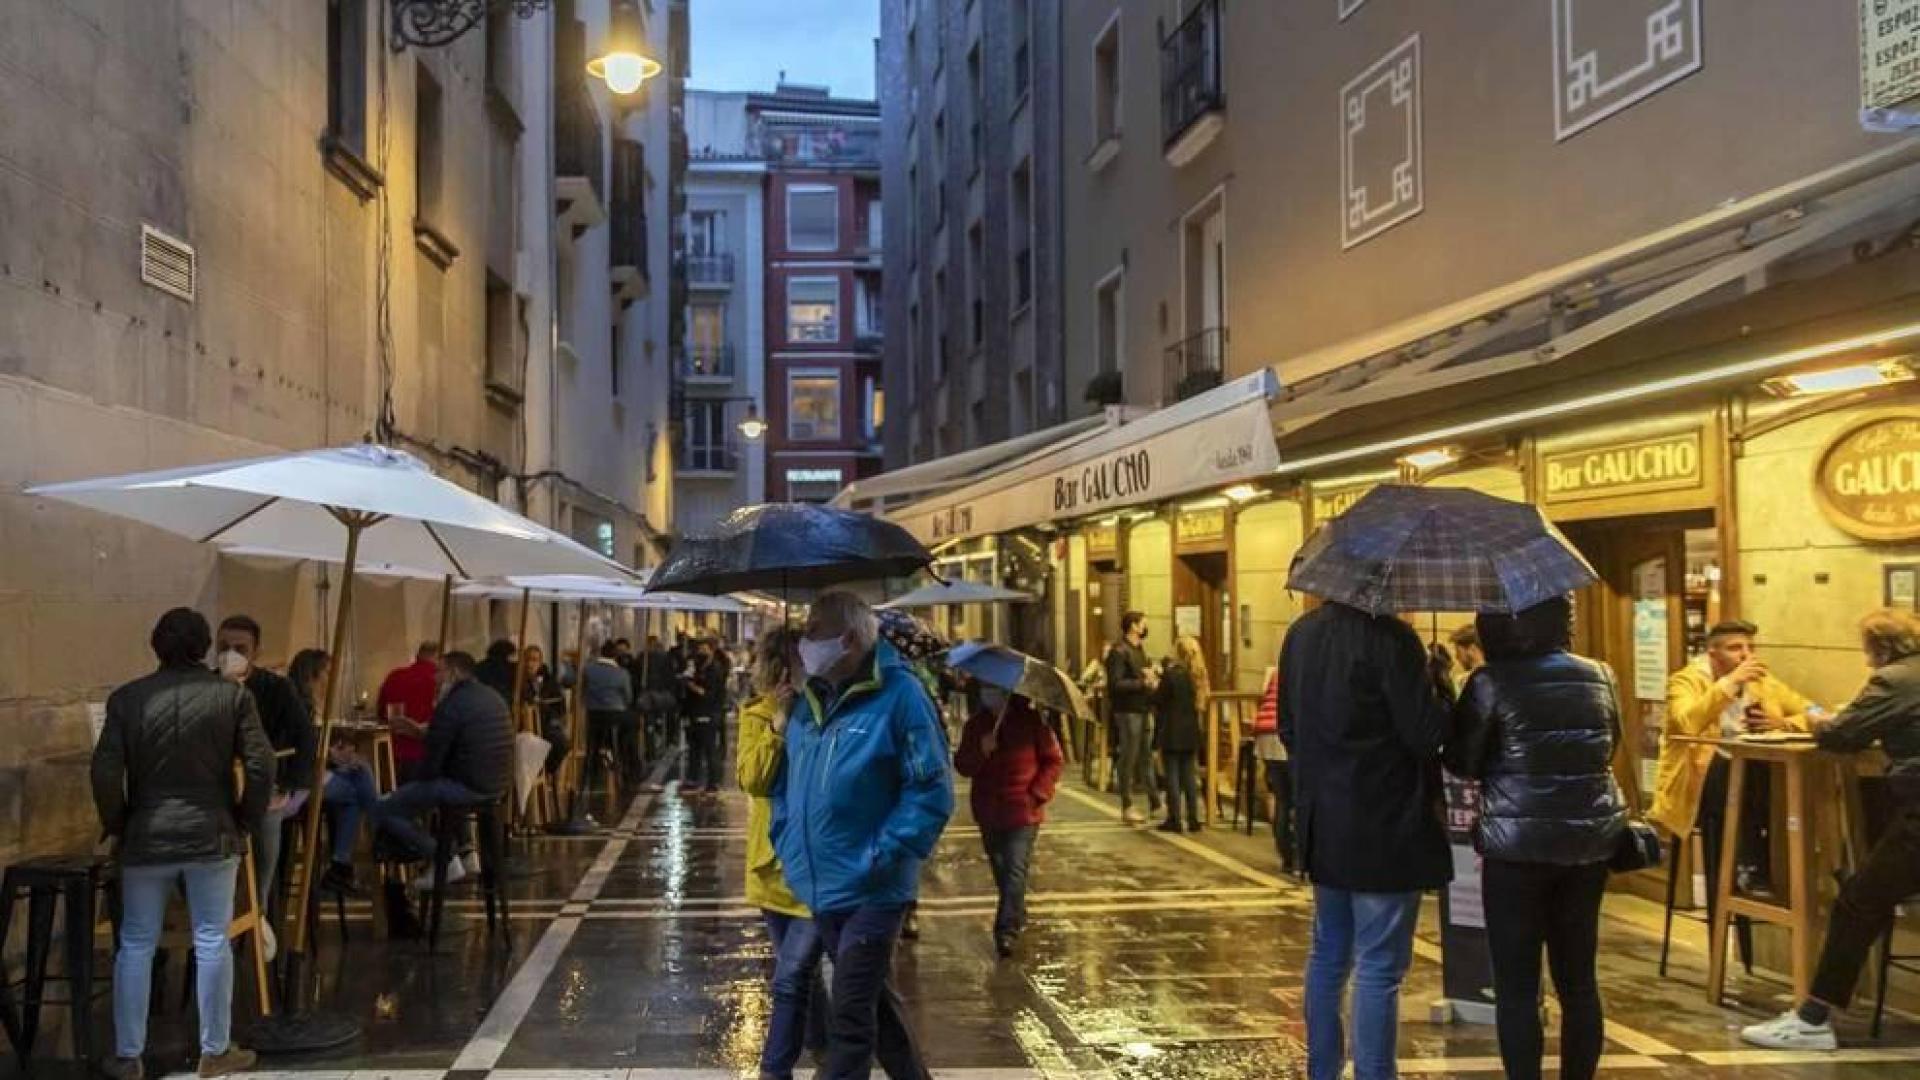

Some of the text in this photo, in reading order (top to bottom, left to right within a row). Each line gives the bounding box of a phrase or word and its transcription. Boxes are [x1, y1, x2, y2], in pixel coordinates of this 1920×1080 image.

[1081, 449, 1150, 504] GAUCHO
[1547, 441, 1697, 492] Bar GAUCHO
